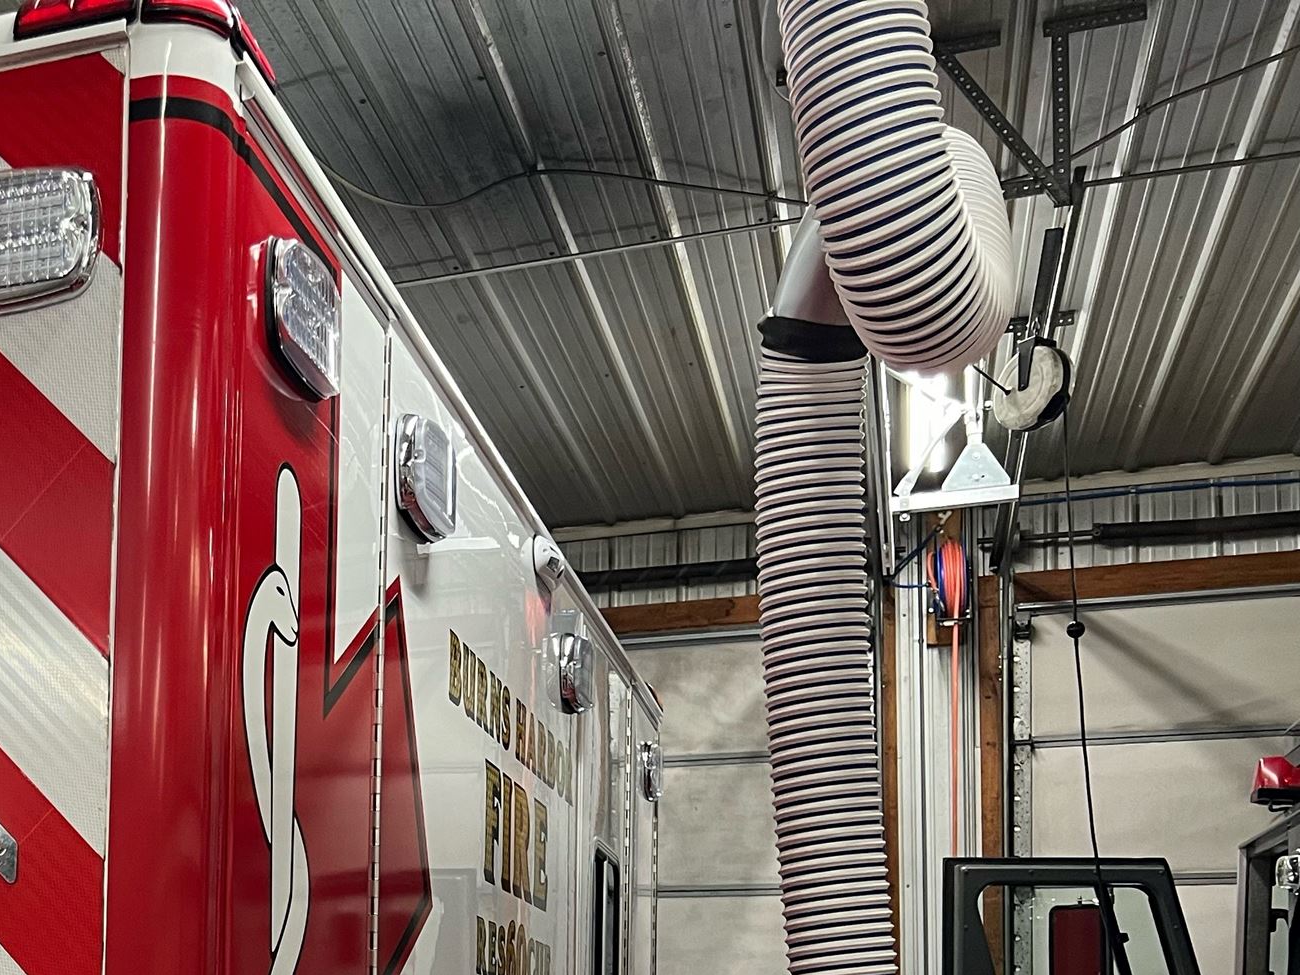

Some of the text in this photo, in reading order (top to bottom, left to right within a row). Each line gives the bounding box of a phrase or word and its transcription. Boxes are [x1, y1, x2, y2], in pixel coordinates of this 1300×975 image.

[448, 629, 574, 807] BURNS HARBOR
[483, 758, 548, 912] FIRE
